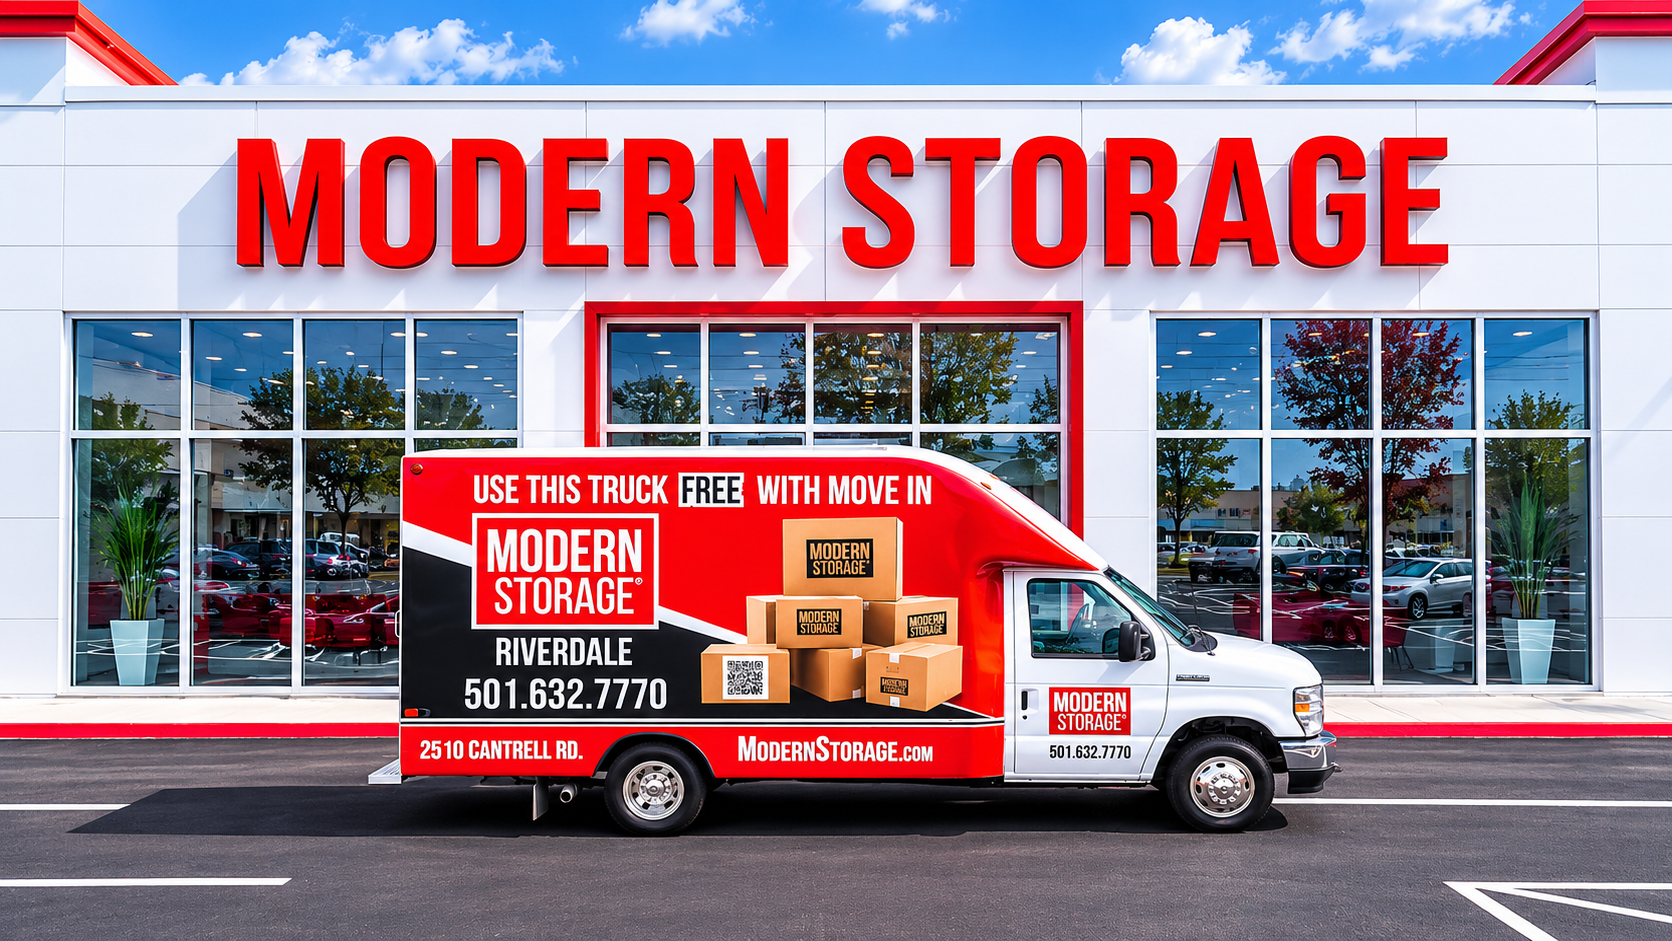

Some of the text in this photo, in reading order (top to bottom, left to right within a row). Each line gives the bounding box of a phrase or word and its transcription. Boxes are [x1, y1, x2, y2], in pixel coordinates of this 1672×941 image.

[236, 135, 1449, 269] MODERN STORAGE
[474, 474, 932, 504] USE THIS TRUCK FREE WITH MOVE IN
[487, 528, 642, 573] MODERN
[810, 542, 870, 560] MODERN
[494, 576, 635, 615] STORAGE
[496, 637, 633, 666] RIVERDALE
[464, 678, 667, 710] 501.632.7770
[1053, 692, 1127, 712] MODERN
[1057, 713, 1122, 731] STORAGE
[419, 740, 583, 760] 2510 CANTRELL RD.
[1049, 745, 1131, 759] 501.632.7770
